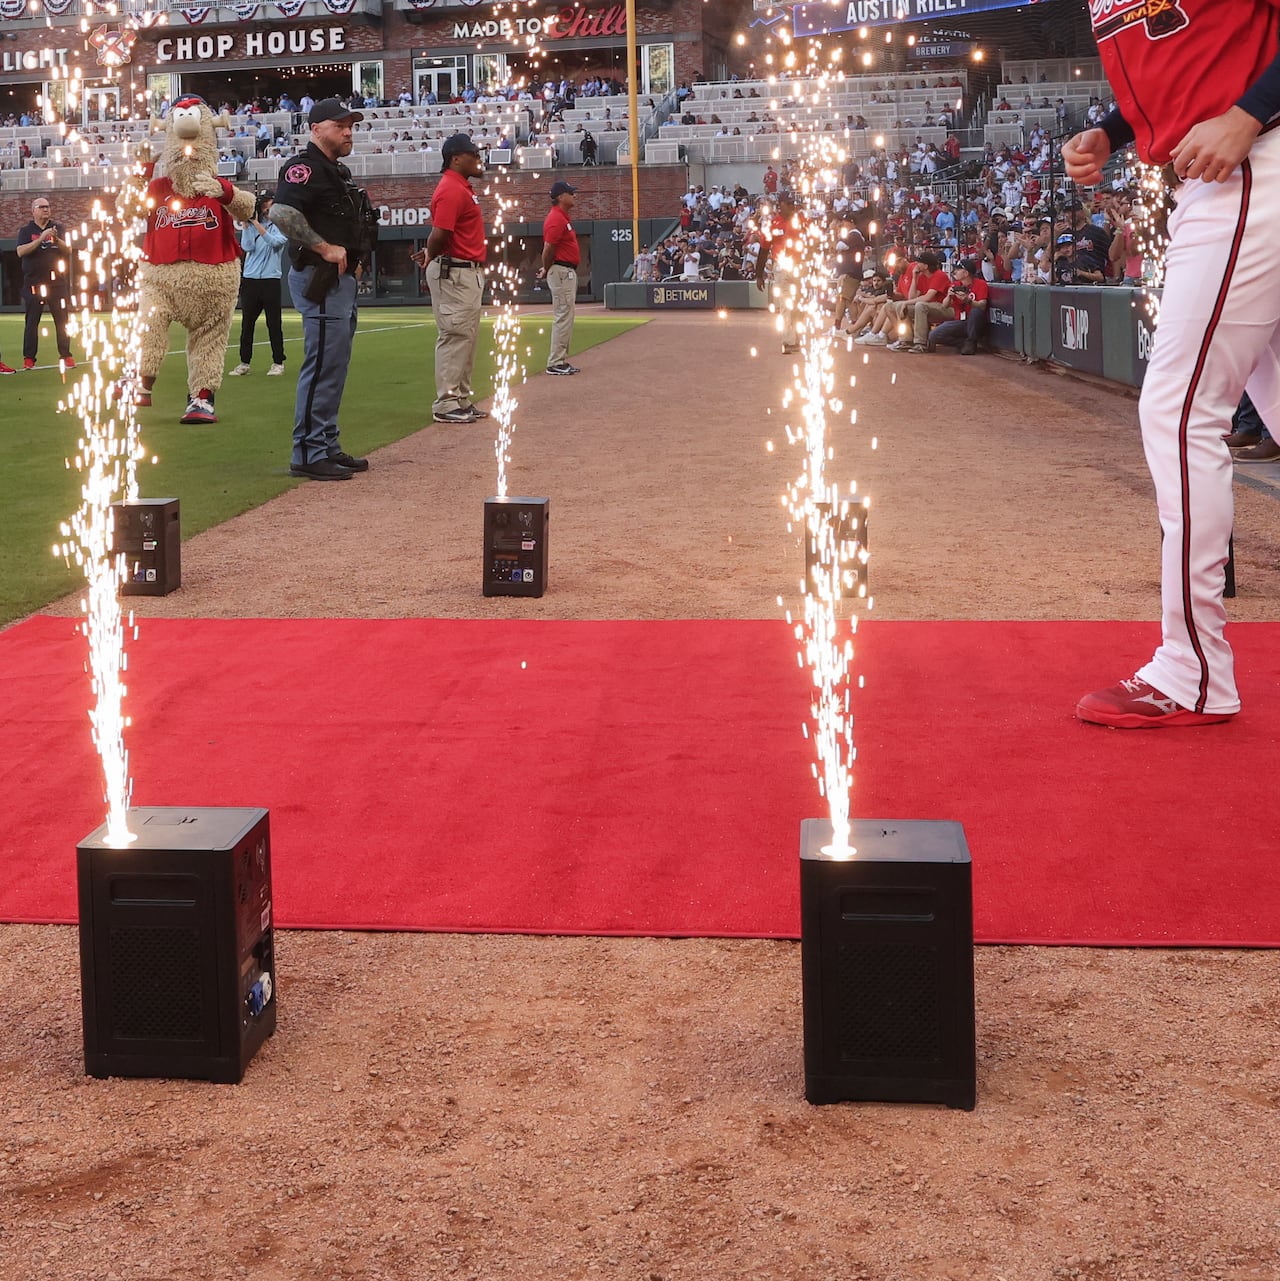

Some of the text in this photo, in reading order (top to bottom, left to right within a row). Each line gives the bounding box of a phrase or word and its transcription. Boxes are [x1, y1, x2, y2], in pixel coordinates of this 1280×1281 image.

[453, 5, 627, 39] MADE TO Chill
[157, 27, 346, 61] CHOP HOUSE
[915, 45, 952, 56] BREWERY
[2, 47, 68, 72] LIGHT
[155, 205, 209, 230] Braves
[377, 205, 431, 226] CHOP
[611, 228, 633, 242] 325
[665, 288, 708, 301] BETMGM
[1076, 309, 1089, 350] APP
